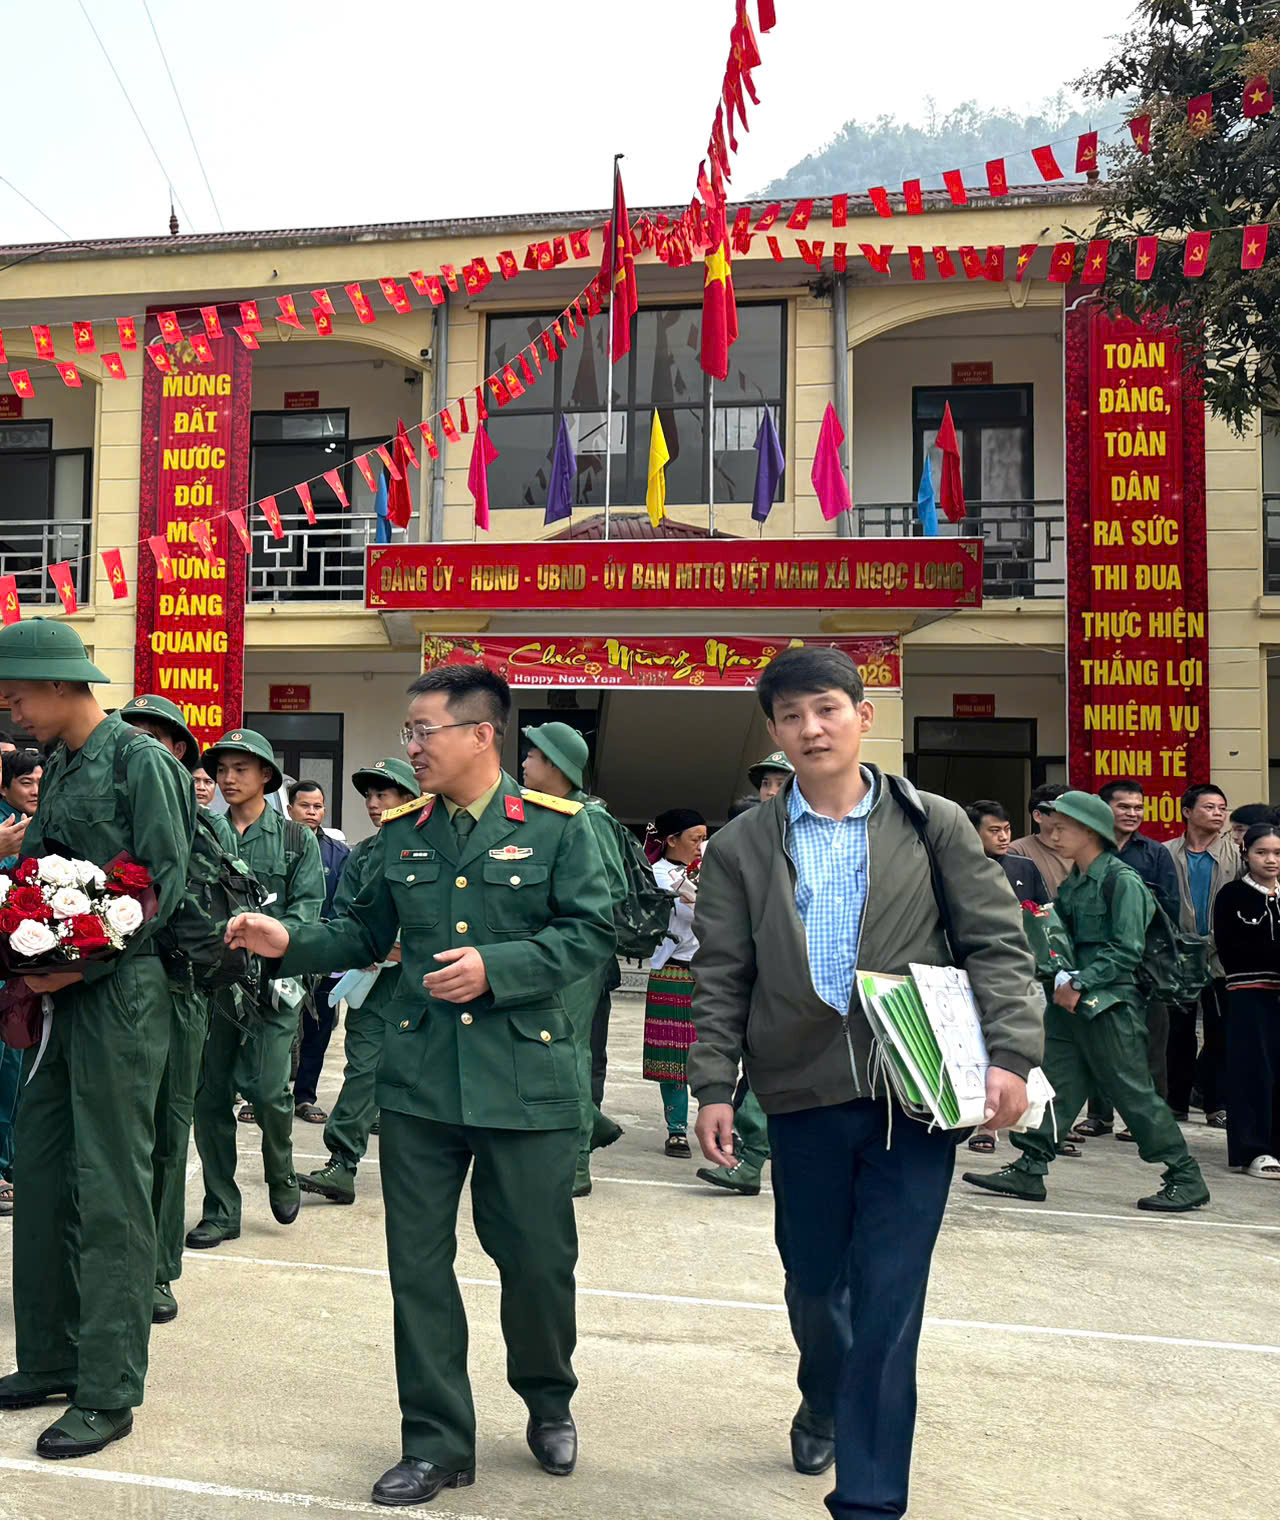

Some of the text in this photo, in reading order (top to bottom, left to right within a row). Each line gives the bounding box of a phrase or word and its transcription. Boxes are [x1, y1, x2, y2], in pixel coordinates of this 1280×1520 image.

[1104, 338, 1165, 369] TOÀN
[162, 370, 231, 397] MỪNG
[1099, 379, 1172, 415] ĐẢNG,
[174, 403, 218, 433] ĐẤT
[163, 443, 226, 470] NƯỚC
[1104, 426, 1166, 457] TOÀN
[174, 476, 213, 506] ĐỔI
[1111, 471, 1160, 501] DÂN
[1094, 514, 1179, 546] RA SỨC
[381, 560, 427, 591] ĐẢNG
[433, 557, 454, 591] ỦY
[471, 565, 519, 591] HĐND
[537, 564, 586, 591] UBND
[603, 556, 627, 590] ỦY
[632, 563, 669, 589] BAN
[676, 563, 725, 592] MTTQ
[731, 557, 770, 594] VIỆT
[775, 563, 819, 590] NAM
[824, 557, 849, 589] XÃ
[855, 563, 909, 595] NGỌC
[914, 562, 964, 589] LONG
[1092, 565, 1182, 590] THI ĐUA
[159, 587, 223, 616] ĐẢNG
[1081, 608, 1204, 644] THỰC HIỆN
[151, 629, 228, 654] QUANG
[158, 668, 219, 692] VINH,
[514, 673, 623, 685] Happy New Year
[857, 663, 892, 686] 026
[1080, 652, 1203, 692] THẮNG LỢI
[177, 700, 223, 727] ỪNG
[1084, 702, 1200, 737] NHIỆM VỤ
[1095, 743, 1187, 776] KINH TẾ
[1143, 790, 1183, 829] HỘI
